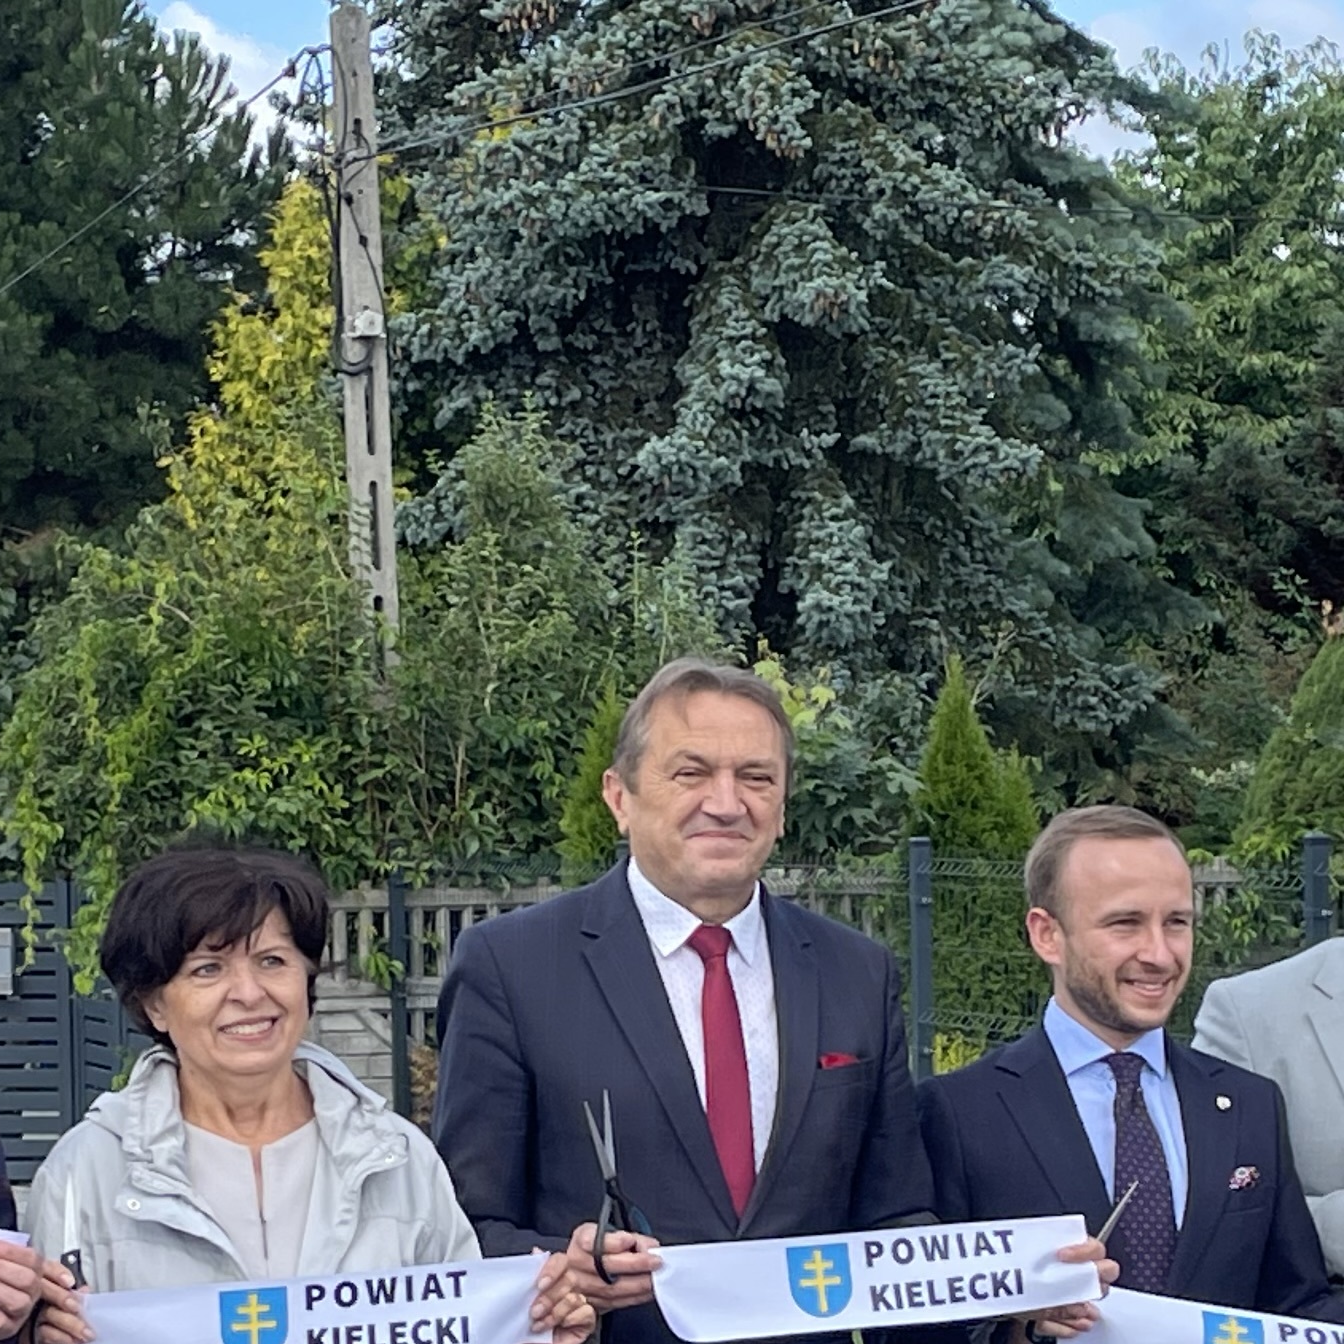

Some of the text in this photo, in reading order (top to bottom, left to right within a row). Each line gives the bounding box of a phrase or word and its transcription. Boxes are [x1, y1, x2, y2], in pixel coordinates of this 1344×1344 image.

[863, 1228, 1015, 1268] POWIAT
[304, 1269, 468, 1311] POWIAT
[869, 1267, 1025, 1312] KIELECKI
